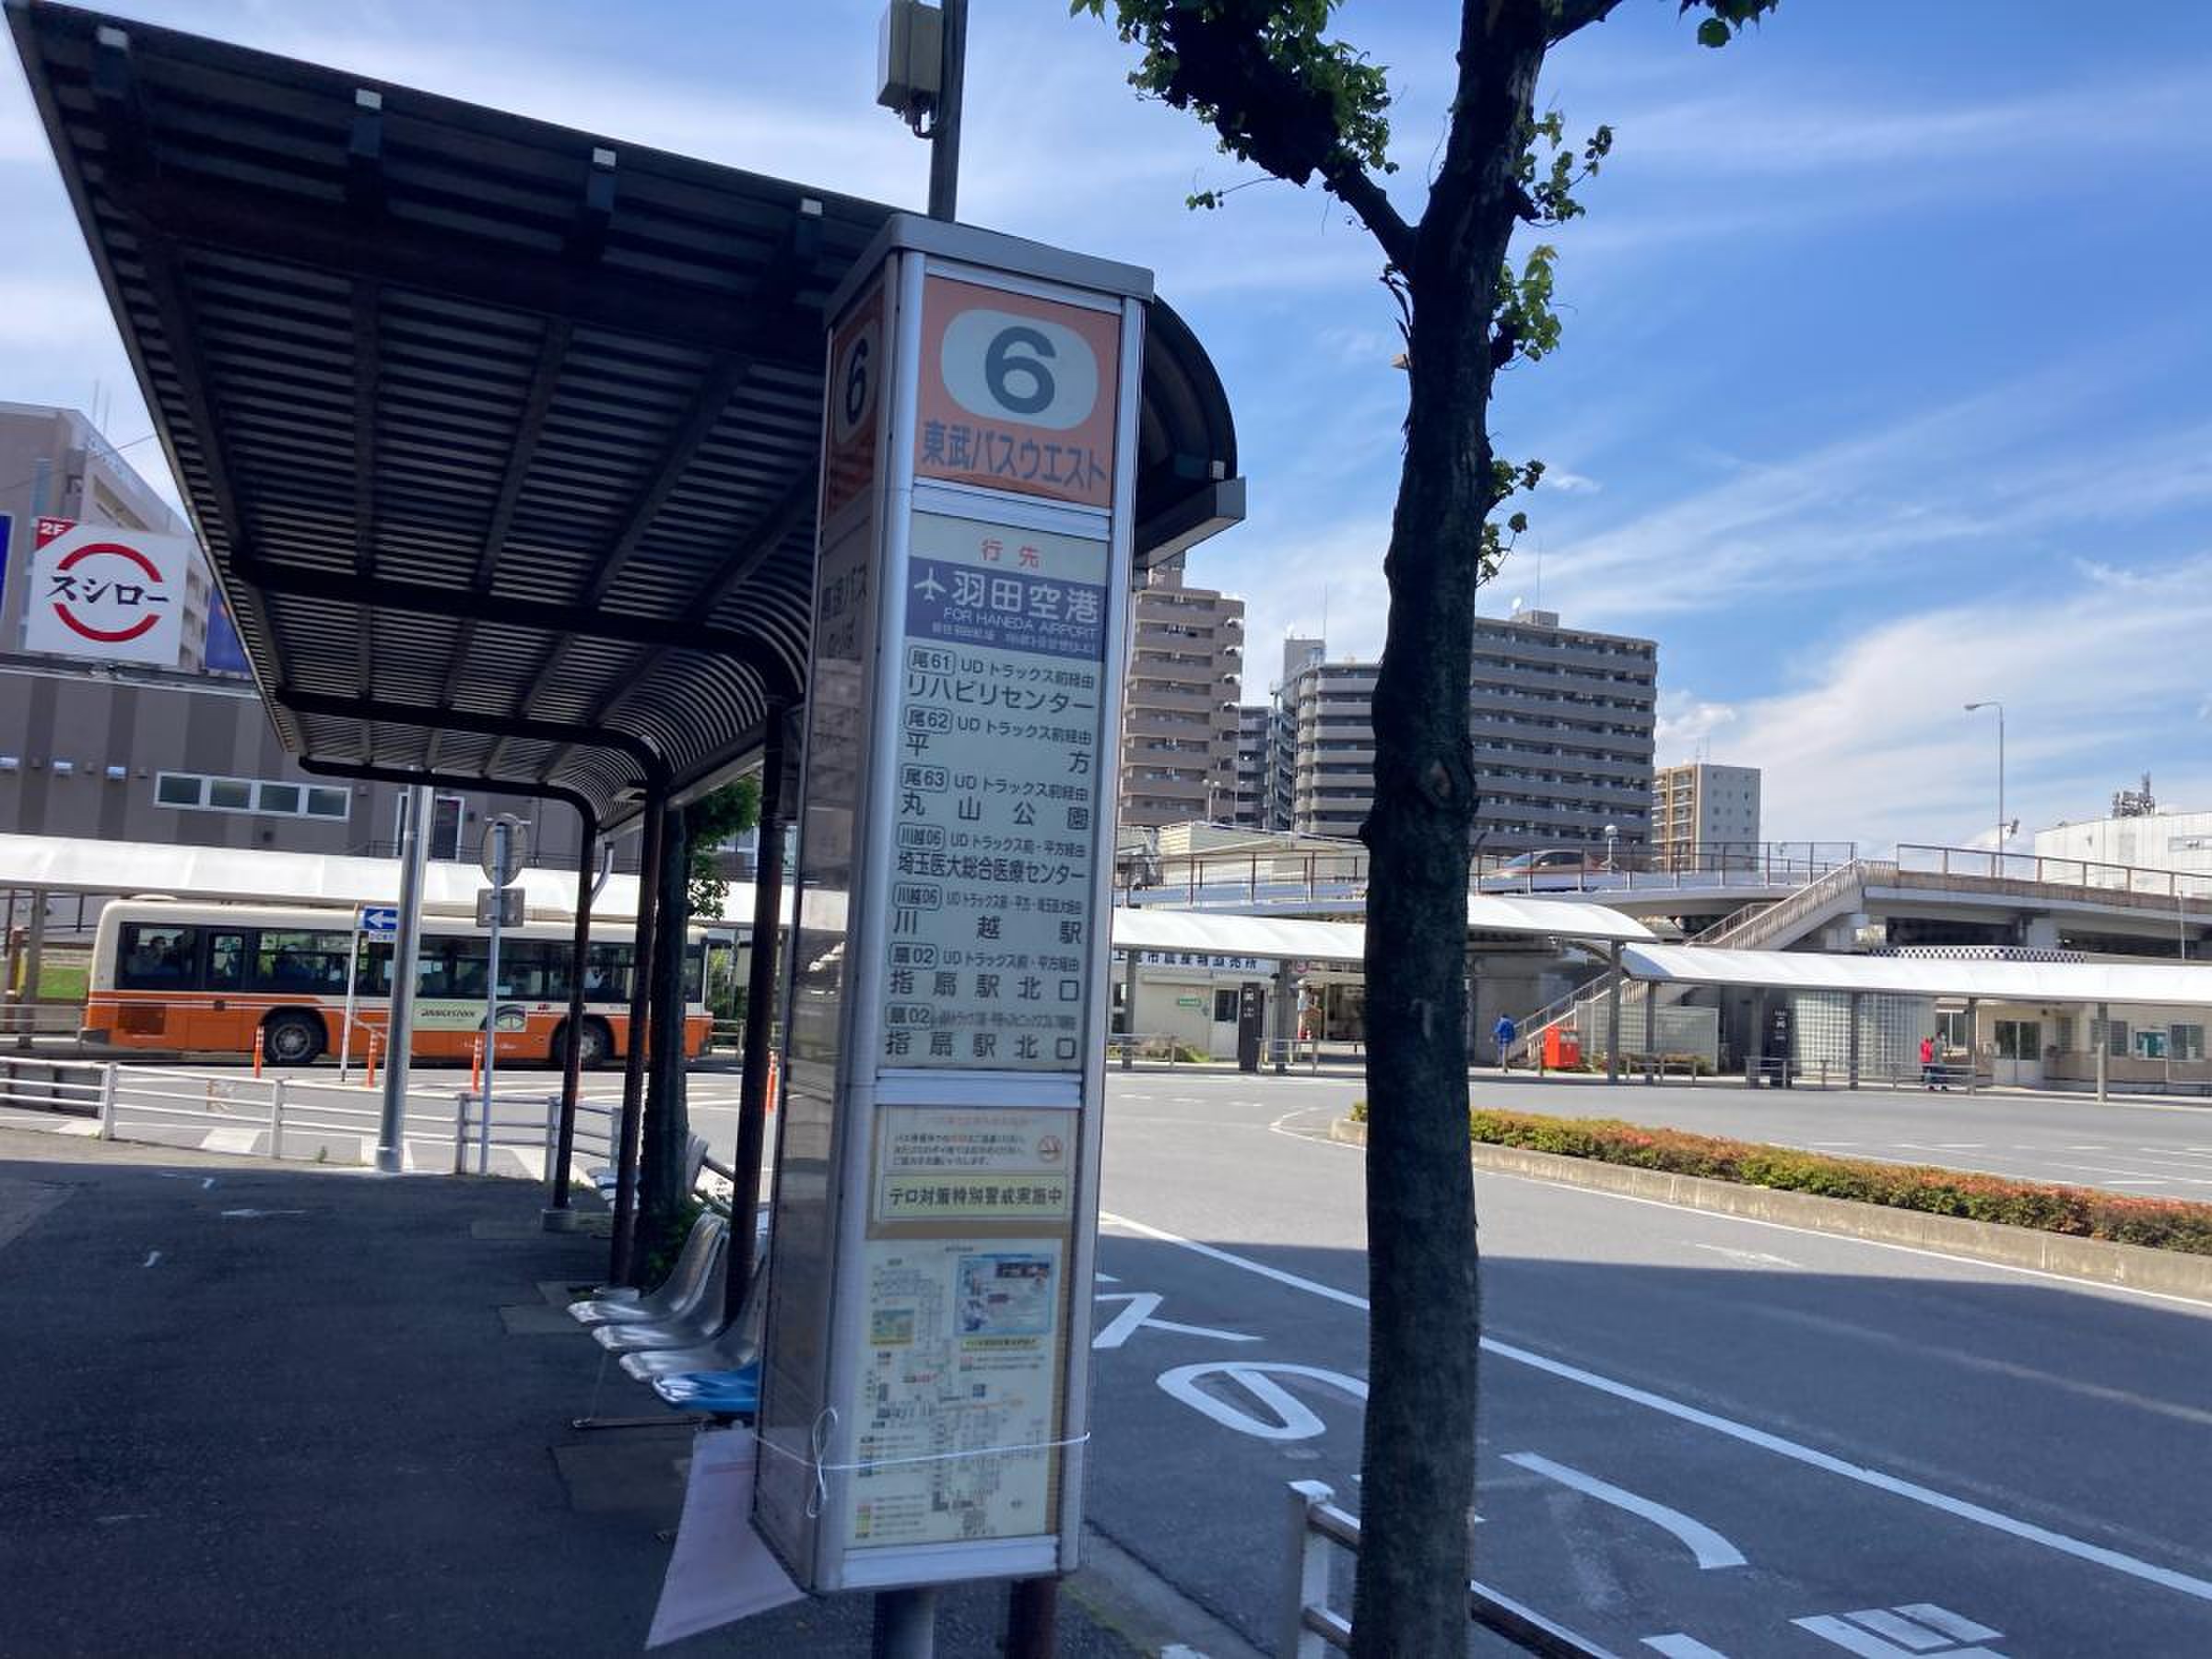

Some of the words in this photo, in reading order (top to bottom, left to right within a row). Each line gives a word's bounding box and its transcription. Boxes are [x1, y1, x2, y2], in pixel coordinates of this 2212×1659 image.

[845, 337, 868, 426] 6
[984, 325, 1057, 415] 6
[921, 419, 1107, 491] 東武バスウエスト
[40, 522, 65, 535] 2F
[981, 537, 1040, 569] 行先
[46, 575, 170, 606] スシロー
[951, 570, 1099, 625] 羽田空港
[943, 606, 973, 624] FOR
[975, 610, 1034, 632] HANEDA
[913, 650, 950, 671] 尾61
[908, 673, 1095, 714] リハビリセンター
[908, 708, 949, 730] 尾62
[902, 767, 945, 788] 尾63
[900, 791, 1089, 831] 丸山公園
[892, 910, 1083, 946] 川越駅
